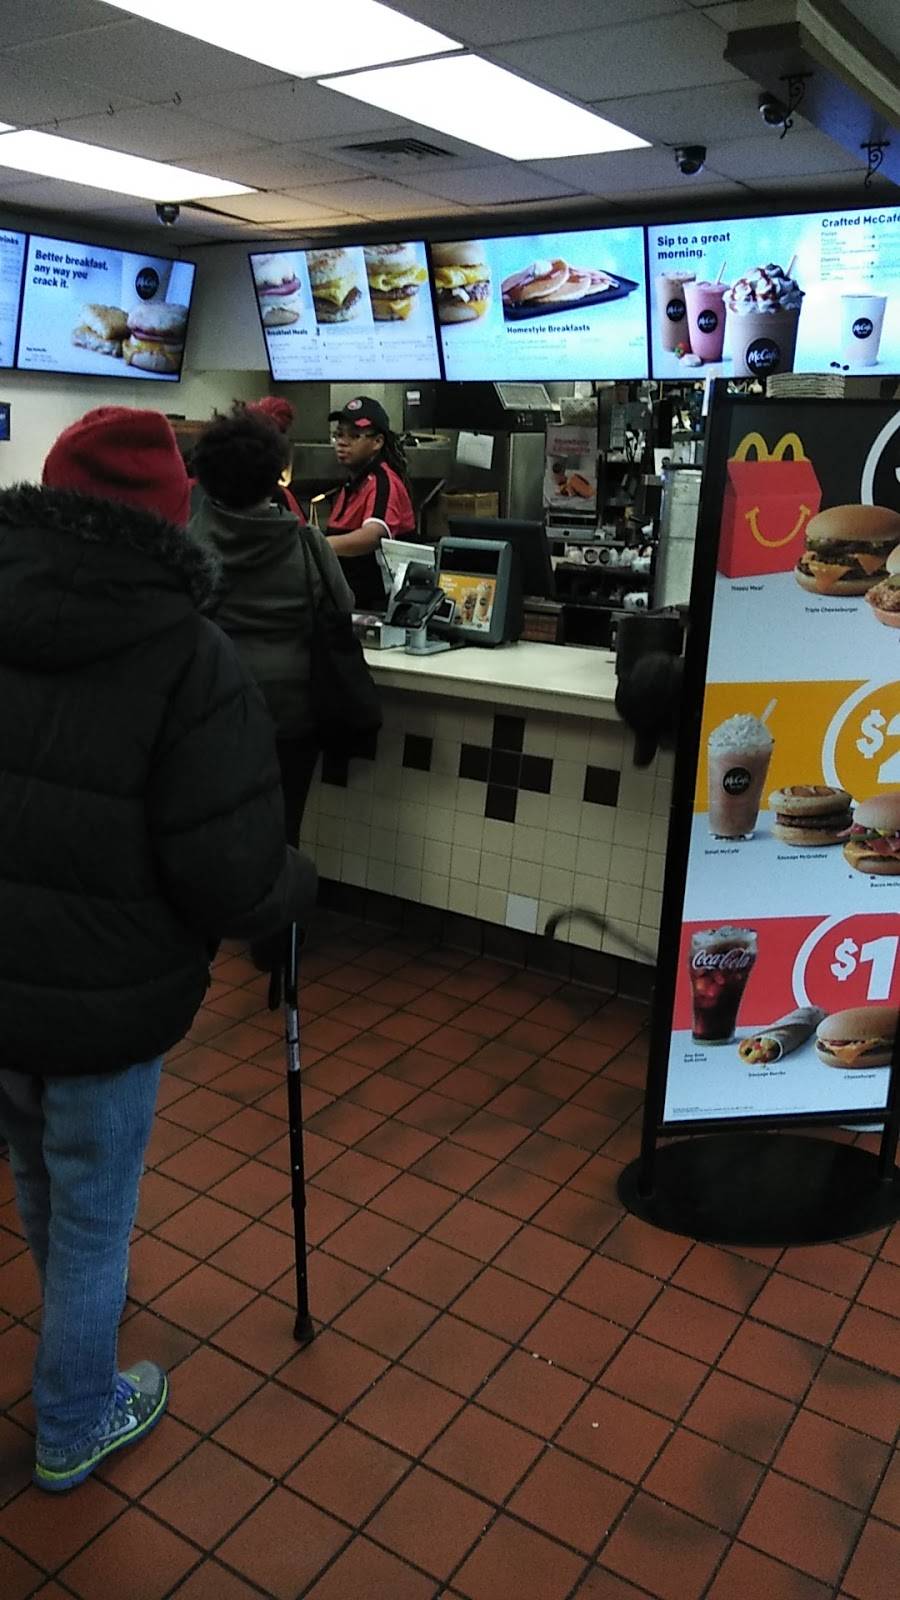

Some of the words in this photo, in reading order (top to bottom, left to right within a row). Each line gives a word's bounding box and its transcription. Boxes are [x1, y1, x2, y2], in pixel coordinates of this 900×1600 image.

[822, 216, 861, 228] Crafted
[657, 235, 675, 248] Sip
[678, 235, 688, 245] to
[691, 236, 698, 244] a
[700, 232, 730, 245] great
[35, 249, 63, 263] Better
[657, 247, 706, 260] morning.
[34, 264, 50, 275] any
[53, 267, 70, 278] way
[72, 270, 88, 280] you
[32, 276, 58, 287] crack
[60, 278, 69, 288] it.
[507, 326, 546, 334] Homestyle
[548, 323, 590, 333] Breakfasts
[830, 936, 899, 1001] $1
